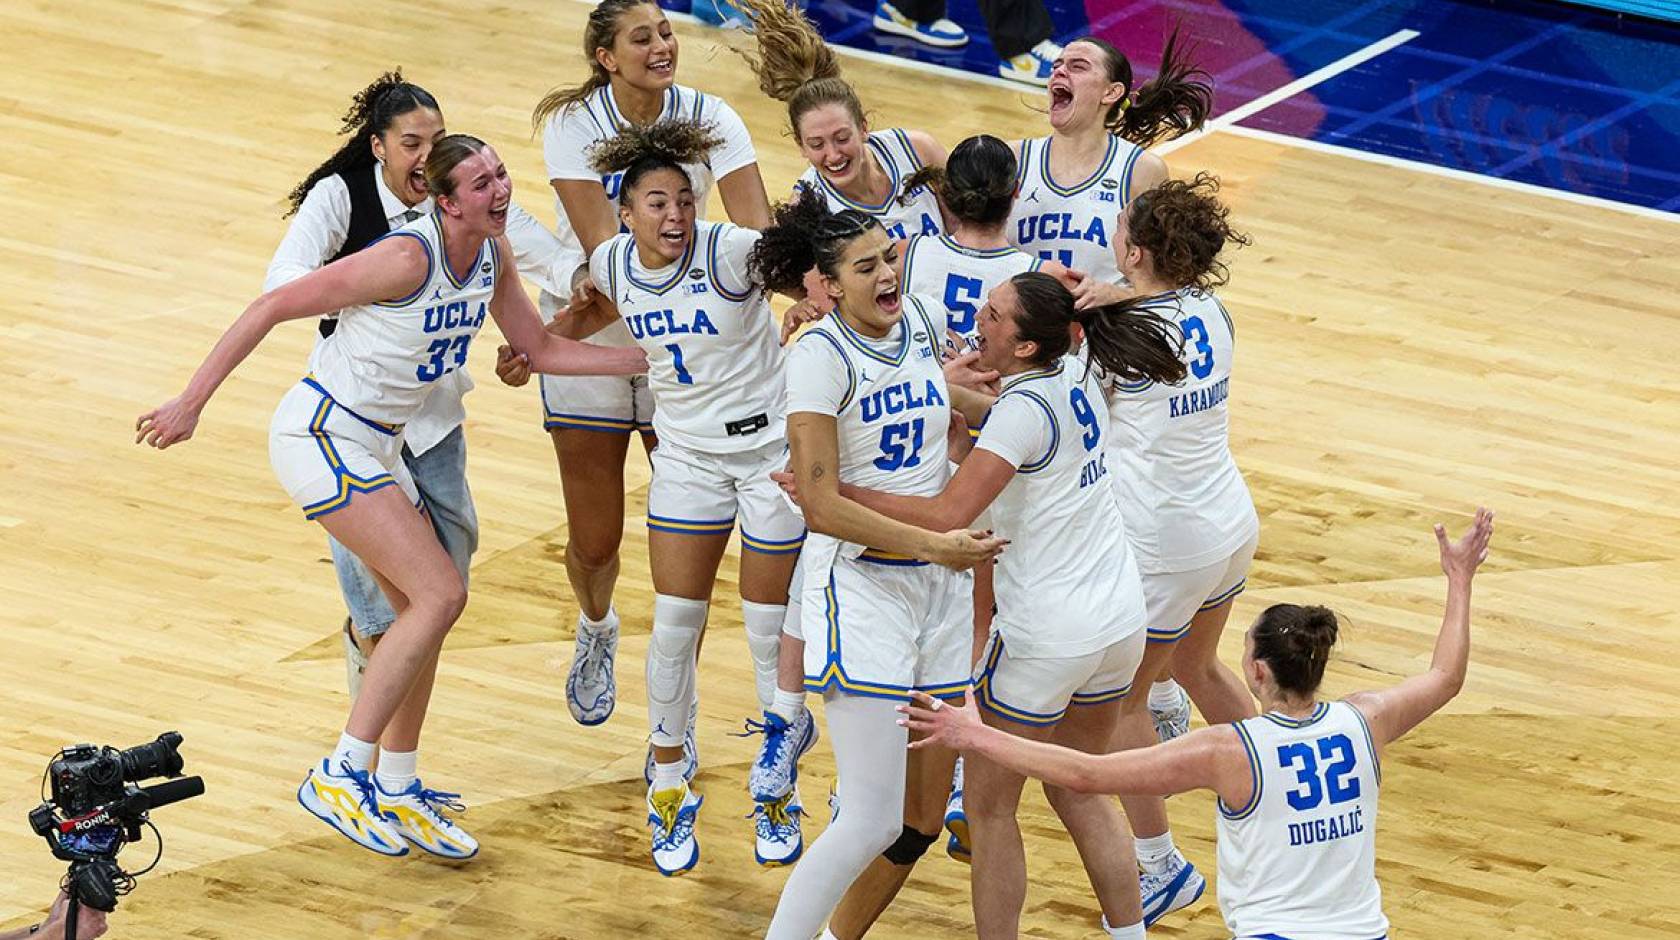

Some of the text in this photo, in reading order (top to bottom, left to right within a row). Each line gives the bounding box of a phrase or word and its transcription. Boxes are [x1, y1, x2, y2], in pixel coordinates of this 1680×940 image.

[1018, 213, 1107, 248] UCLA
[423, 301, 485, 333] UCLA
[626, 309, 718, 340] UCLA
[943, 272, 982, 334] 5
[416, 334, 471, 382] 33
[665, 343, 693, 385] 1
[1180, 315, 1214, 380] 3
[860, 379, 944, 423] UCLA
[1070, 387, 1100, 452] 9
[873, 418, 923, 472] 51
[1277, 734, 1360, 811] 32
[75, 811, 109, 831] RONIN
